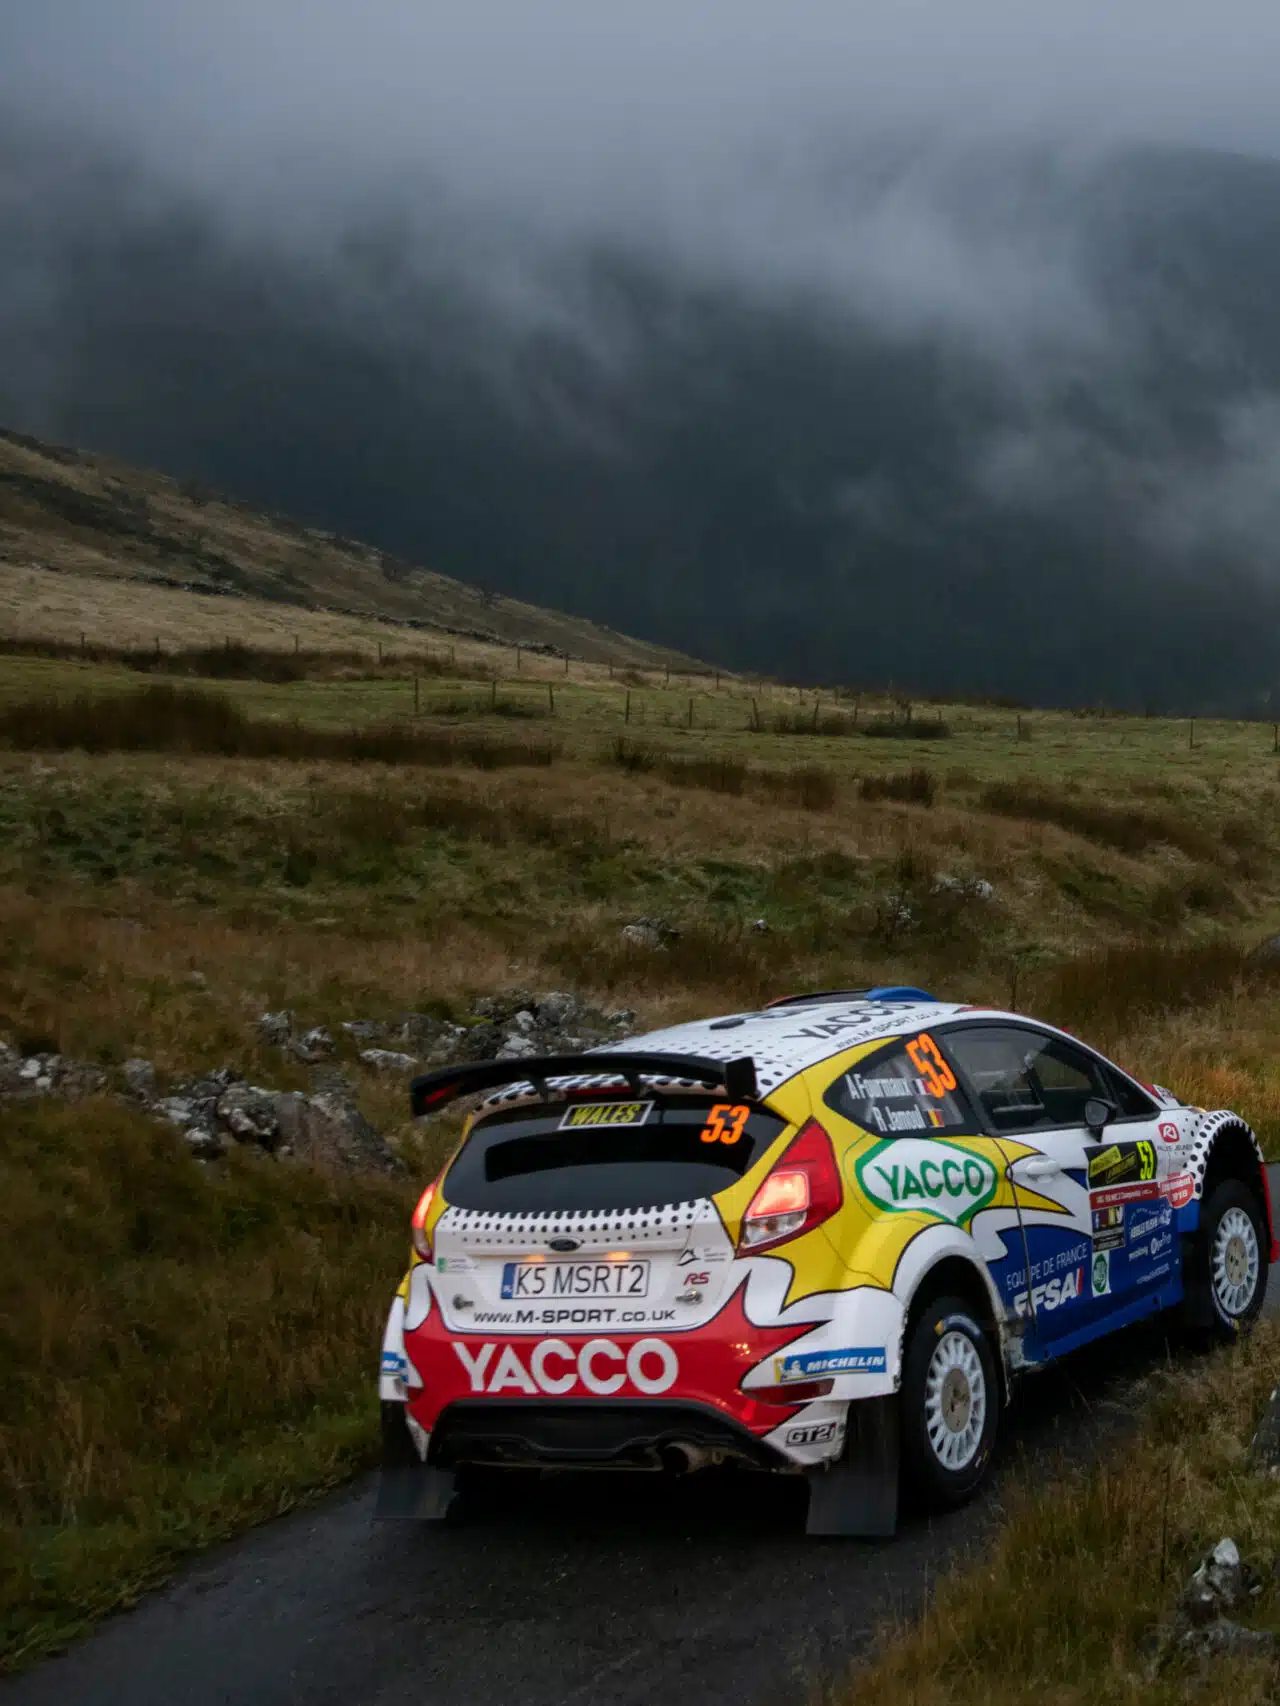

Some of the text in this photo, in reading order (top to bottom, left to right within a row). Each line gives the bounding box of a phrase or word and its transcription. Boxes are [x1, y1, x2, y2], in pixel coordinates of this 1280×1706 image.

[904, 1033, 956, 1099] 53
[570, 1103, 641, 1126] WALES
[701, 1104, 750, 1145] 53
[871, 1106, 888, 1132] R
[1136, 1141, 1154, 1181] 53
[873, 1159, 985, 1201] YACCO
[1043, 1257, 1055, 1277] DE
[1056, 1242, 1088, 1271] FRANCE
[516, 1264, 645, 1296] K5 MSRT2
[683, 1271, 711, 1286] RS
[1013, 1272, 1078, 1319] FFSA
[452, 1338, 680, 1395] YACCO
[806, 1356, 885, 1373] MICHELIN
